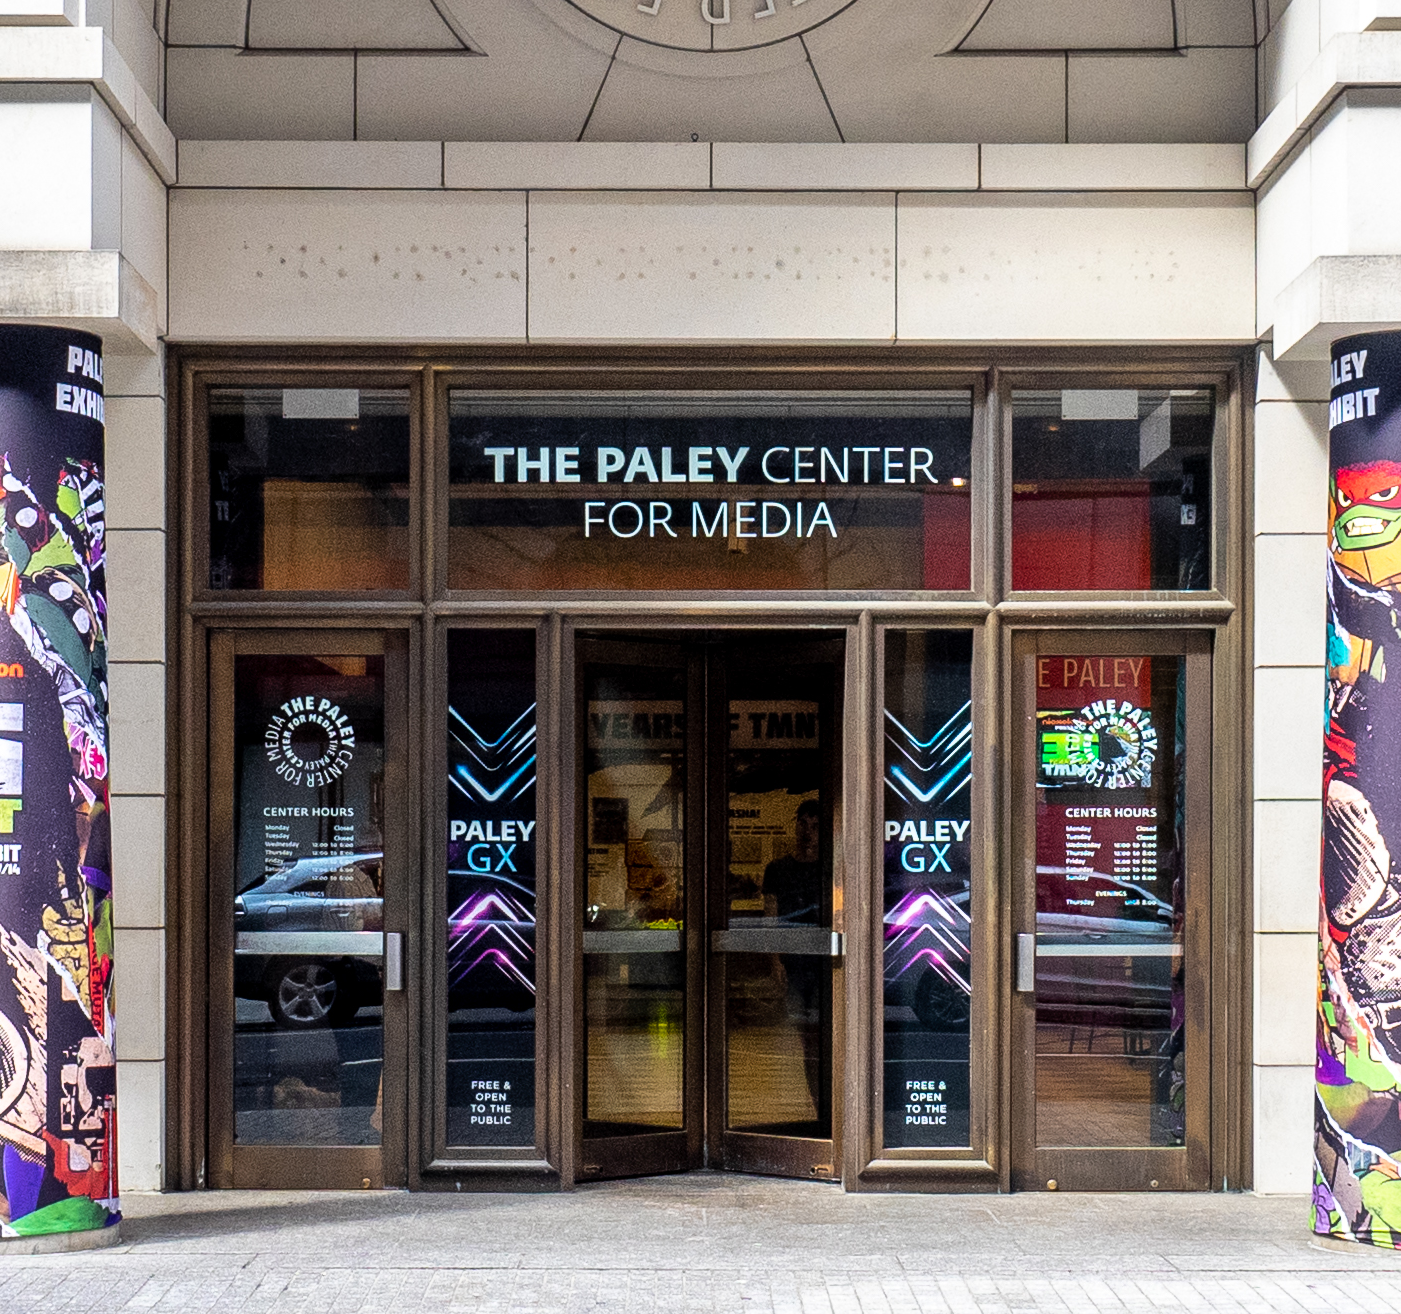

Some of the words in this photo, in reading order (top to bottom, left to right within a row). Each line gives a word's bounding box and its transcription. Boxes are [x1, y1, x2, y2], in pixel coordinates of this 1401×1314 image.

[484, 447, 580, 482] THE
[598, 447, 750, 482] PALEY
[761, 446, 938, 483] CENTER
[584, 501, 677, 538] FOR
[693, 501, 838, 538] MEDIA
[1064, 659, 1143, 687] PALEY
[281, 696, 314, 717] THE
[1081, 699, 1116, 720] THE
[288, 714, 306, 730] FOR
[309, 714, 336, 738] MEDIA
[318, 698, 355, 748] PALEY
[1088, 717, 1108, 733] FOR
[1109, 716, 1139, 741] MEDIA
[1119, 701, 1157, 750] PALEY
[265, 715, 285, 761] MEDIA
[282, 731, 303, 767] CENTER
[276, 761, 302, 785] FOR
[307, 750, 353, 787] CENTER
[1108, 749, 1155, 789] CENTER
[263, 807, 309, 817] CENTER
[312, 807, 354, 817] HOURS
[1065, 808, 1112, 817] CENTER
[1114, 808, 1157, 817] HOURS
[450, 820, 536, 841] PALEY
[885, 820, 970, 841] PALEY
[467, 843, 517, 872] GX
[901, 843, 952, 873] GX
[471, 1081, 500, 1090] FREE
[504, 1081, 511, 1090] &
[906, 1081, 935, 1090] FREE
[939, 1081, 946, 1090] &
[475, 1093, 506, 1101] OPEN
[910, 1093, 942, 1102] OPEN
[470, 1104, 486, 1113] TO
[490, 1104, 512, 1113] THE
[905, 1104, 921, 1113] TO
[925, 1104, 947, 1113] THE
[471, 1116, 512, 1124] PUBLIC
[905, 1116, 947, 1125] PUBLIC
